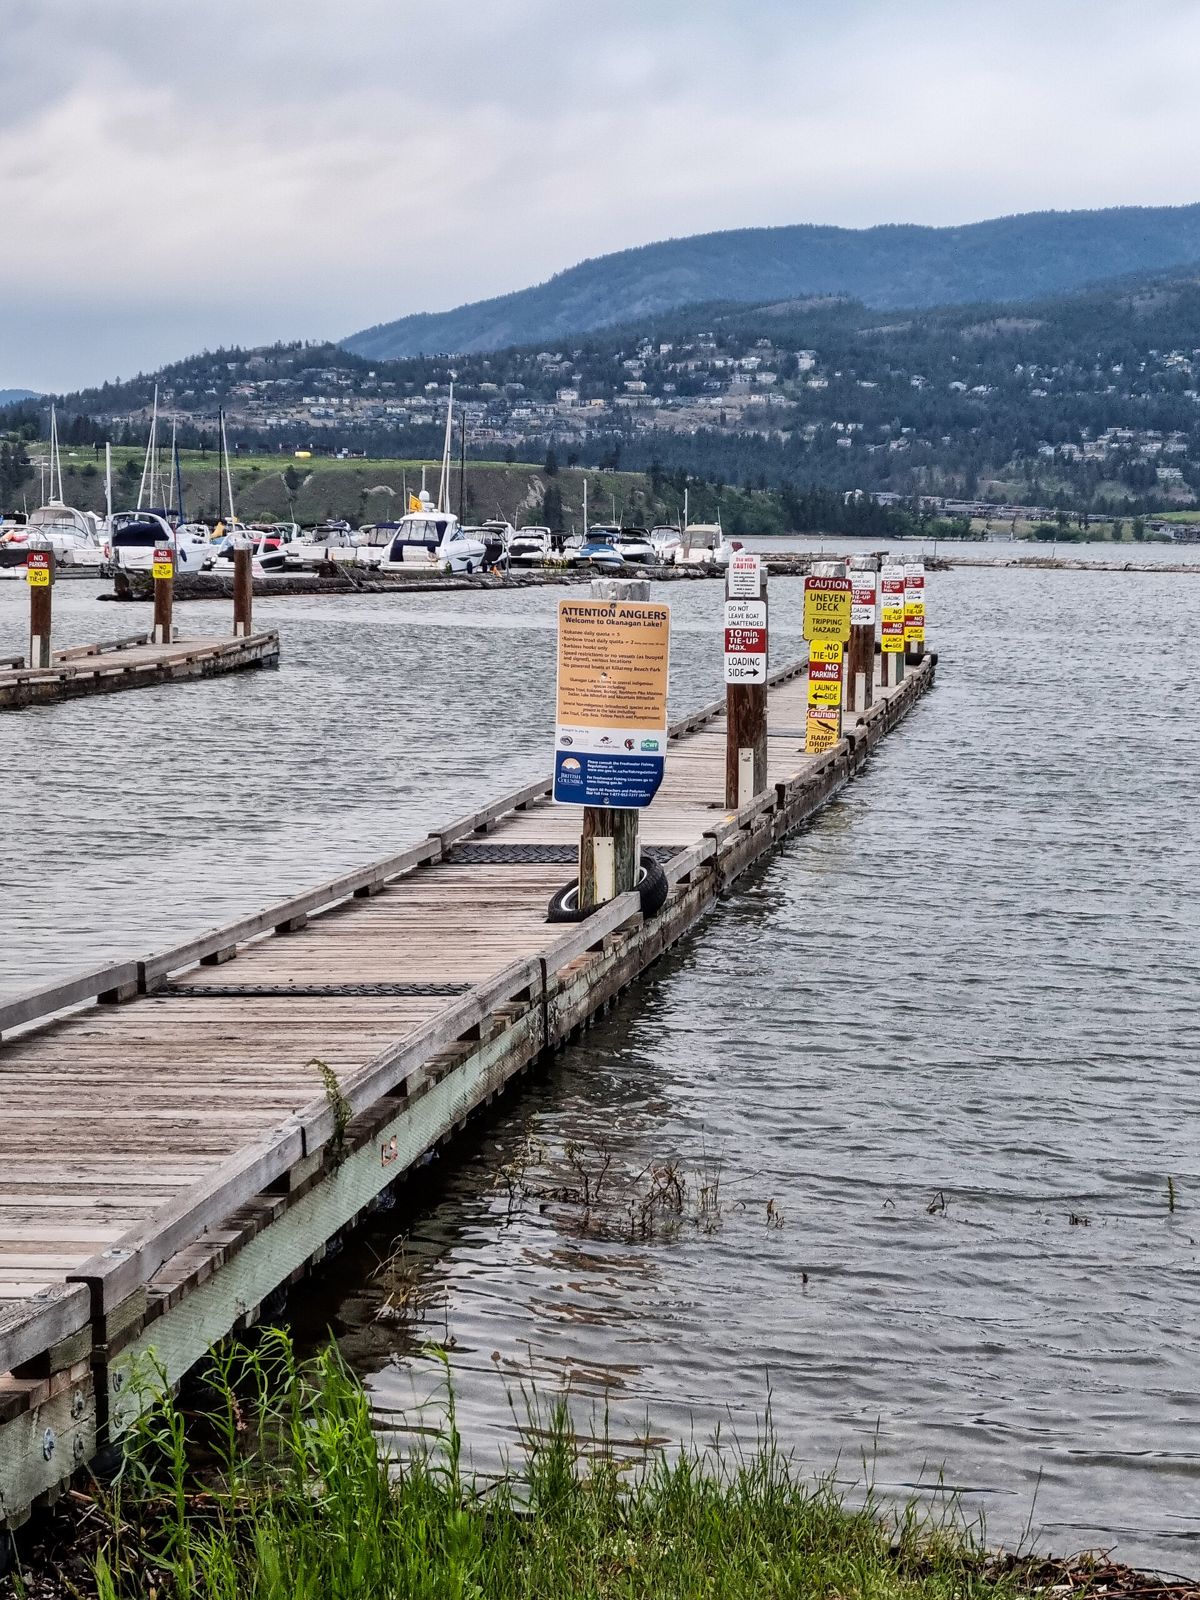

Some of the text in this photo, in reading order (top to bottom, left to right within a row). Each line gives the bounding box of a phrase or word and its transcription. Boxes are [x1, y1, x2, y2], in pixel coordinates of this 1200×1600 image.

[809, 580, 849, 589] CAUTION
[810, 593, 846, 602] UNEVEN
[816, 603, 839, 611] DECK
[562, 607, 666, 620] ATTENTION ANGLERS
[813, 652, 839, 660] TIE-UP
[728, 658, 760, 666] LOADING
[728, 668, 744, 677] SIDE
[811, 671, 838, 679] PARKING
